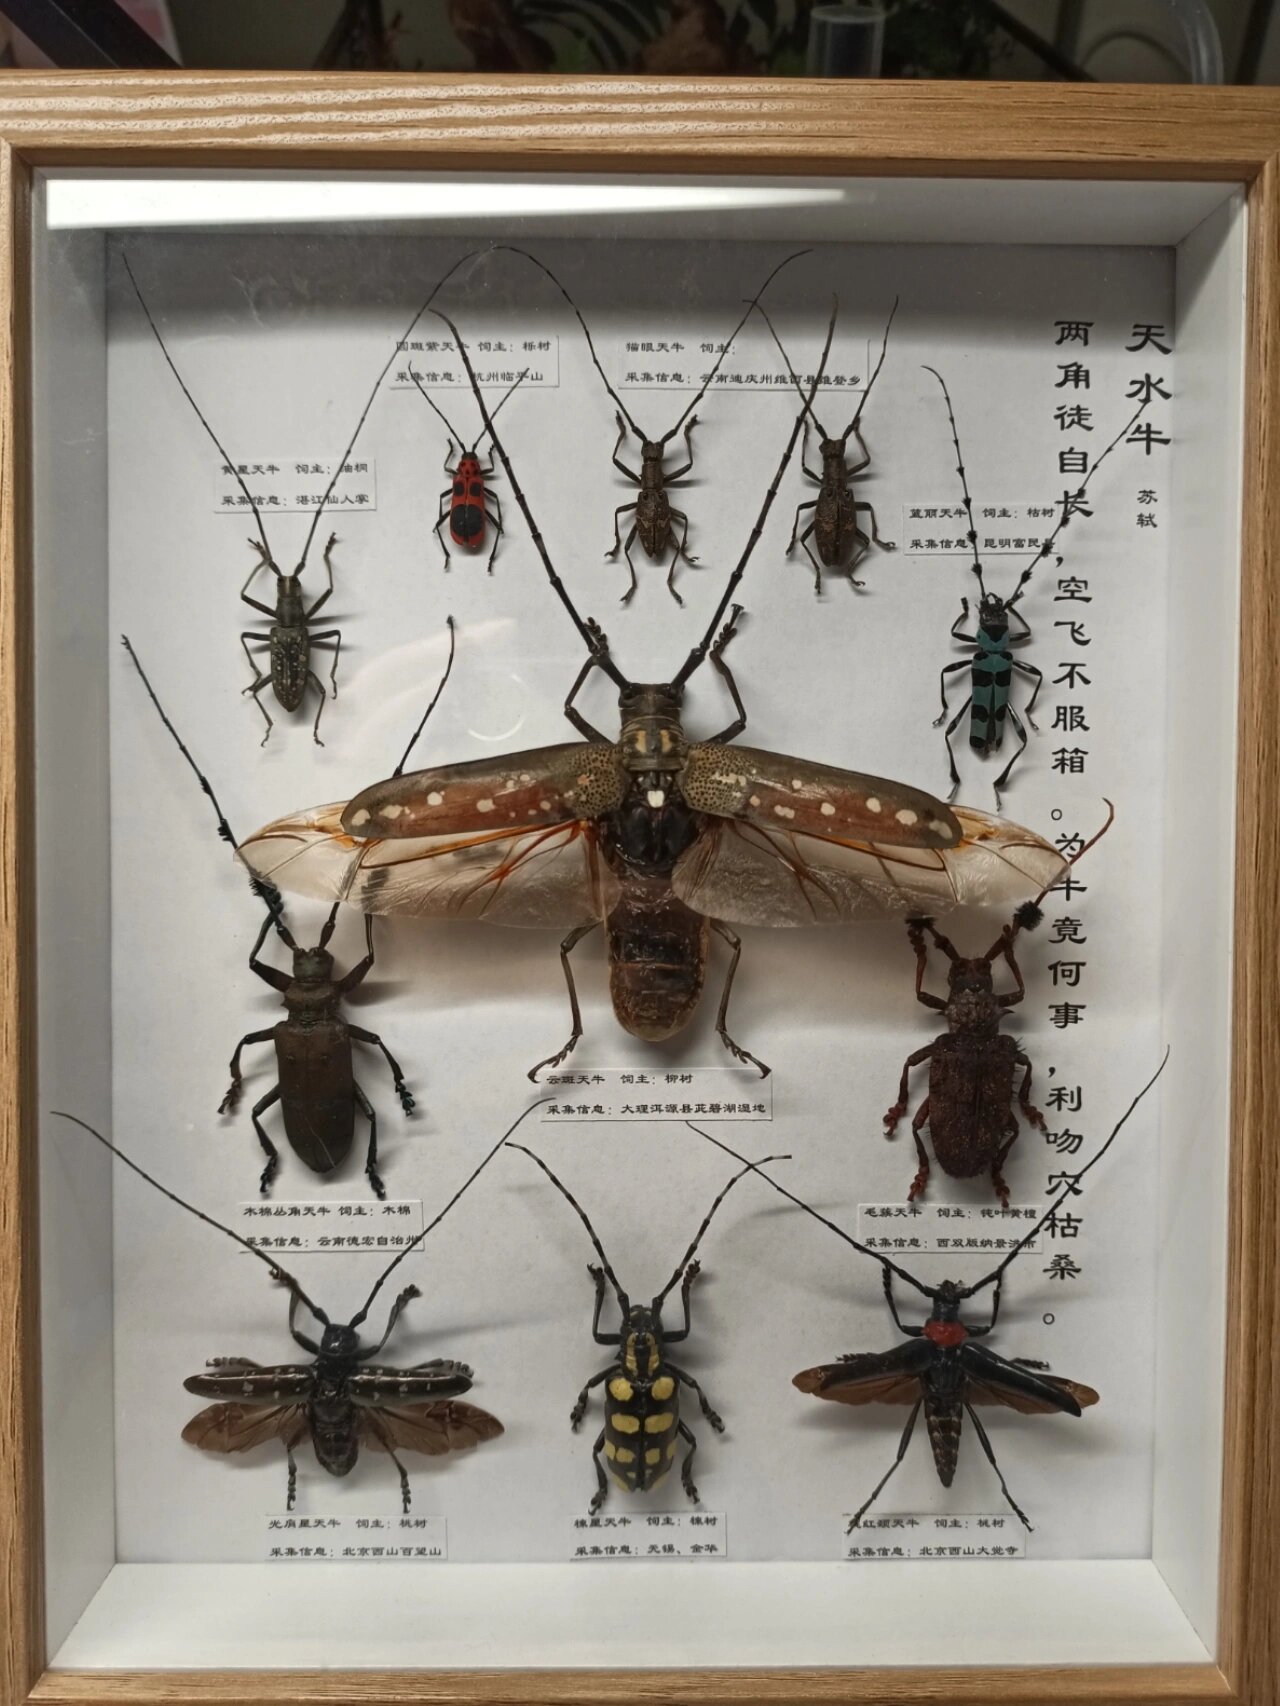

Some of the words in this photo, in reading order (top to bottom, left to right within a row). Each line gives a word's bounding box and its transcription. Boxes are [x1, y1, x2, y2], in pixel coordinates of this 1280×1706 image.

[626, 342, 685, 353] 猫眼天牛
[1125, 323, 1172, 456] 天水牛
[1137, 489, 1158, 528] 苏轼
[546, 1074, 605, 1085] 云斑天牛
[268, 1518, 341, 1530] 光肩星天牛
